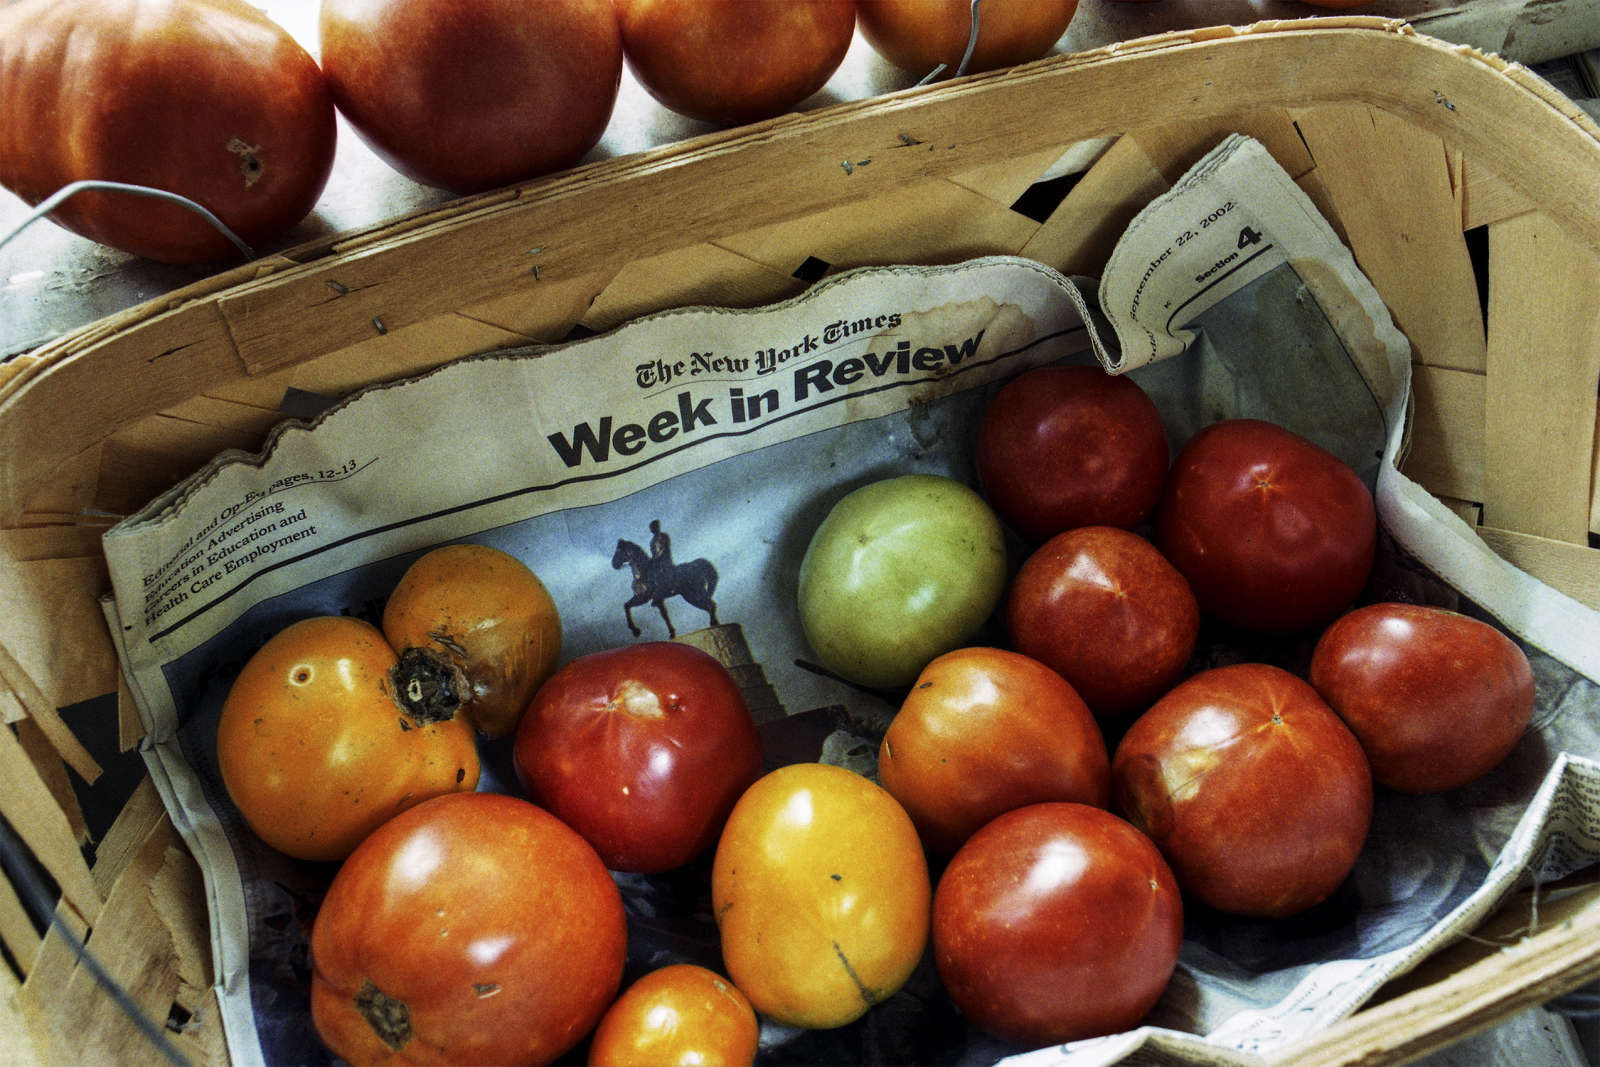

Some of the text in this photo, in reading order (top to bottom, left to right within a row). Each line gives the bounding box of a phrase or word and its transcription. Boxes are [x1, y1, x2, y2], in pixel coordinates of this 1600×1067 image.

[1175, 231, 1199, 247] 22,
[1200, 201, 1235, 229] 2002
[1195, 225, 1263, 283] Section 4
[635, 312, 902, 389] The New York Times
[547, 329, 986, 468] Week in Review
[196, 516, 218, 541] and
[318, 459, 357, 479] 12-13
[207, 501, 285, 551] Advertising
[190, 571, 223, 594] Care
[223, 525, 318, 575] Employment
[191, 564, 205, 578] in
[206, 523, 277, 567] Education
[279, 508, 308, 528] and
